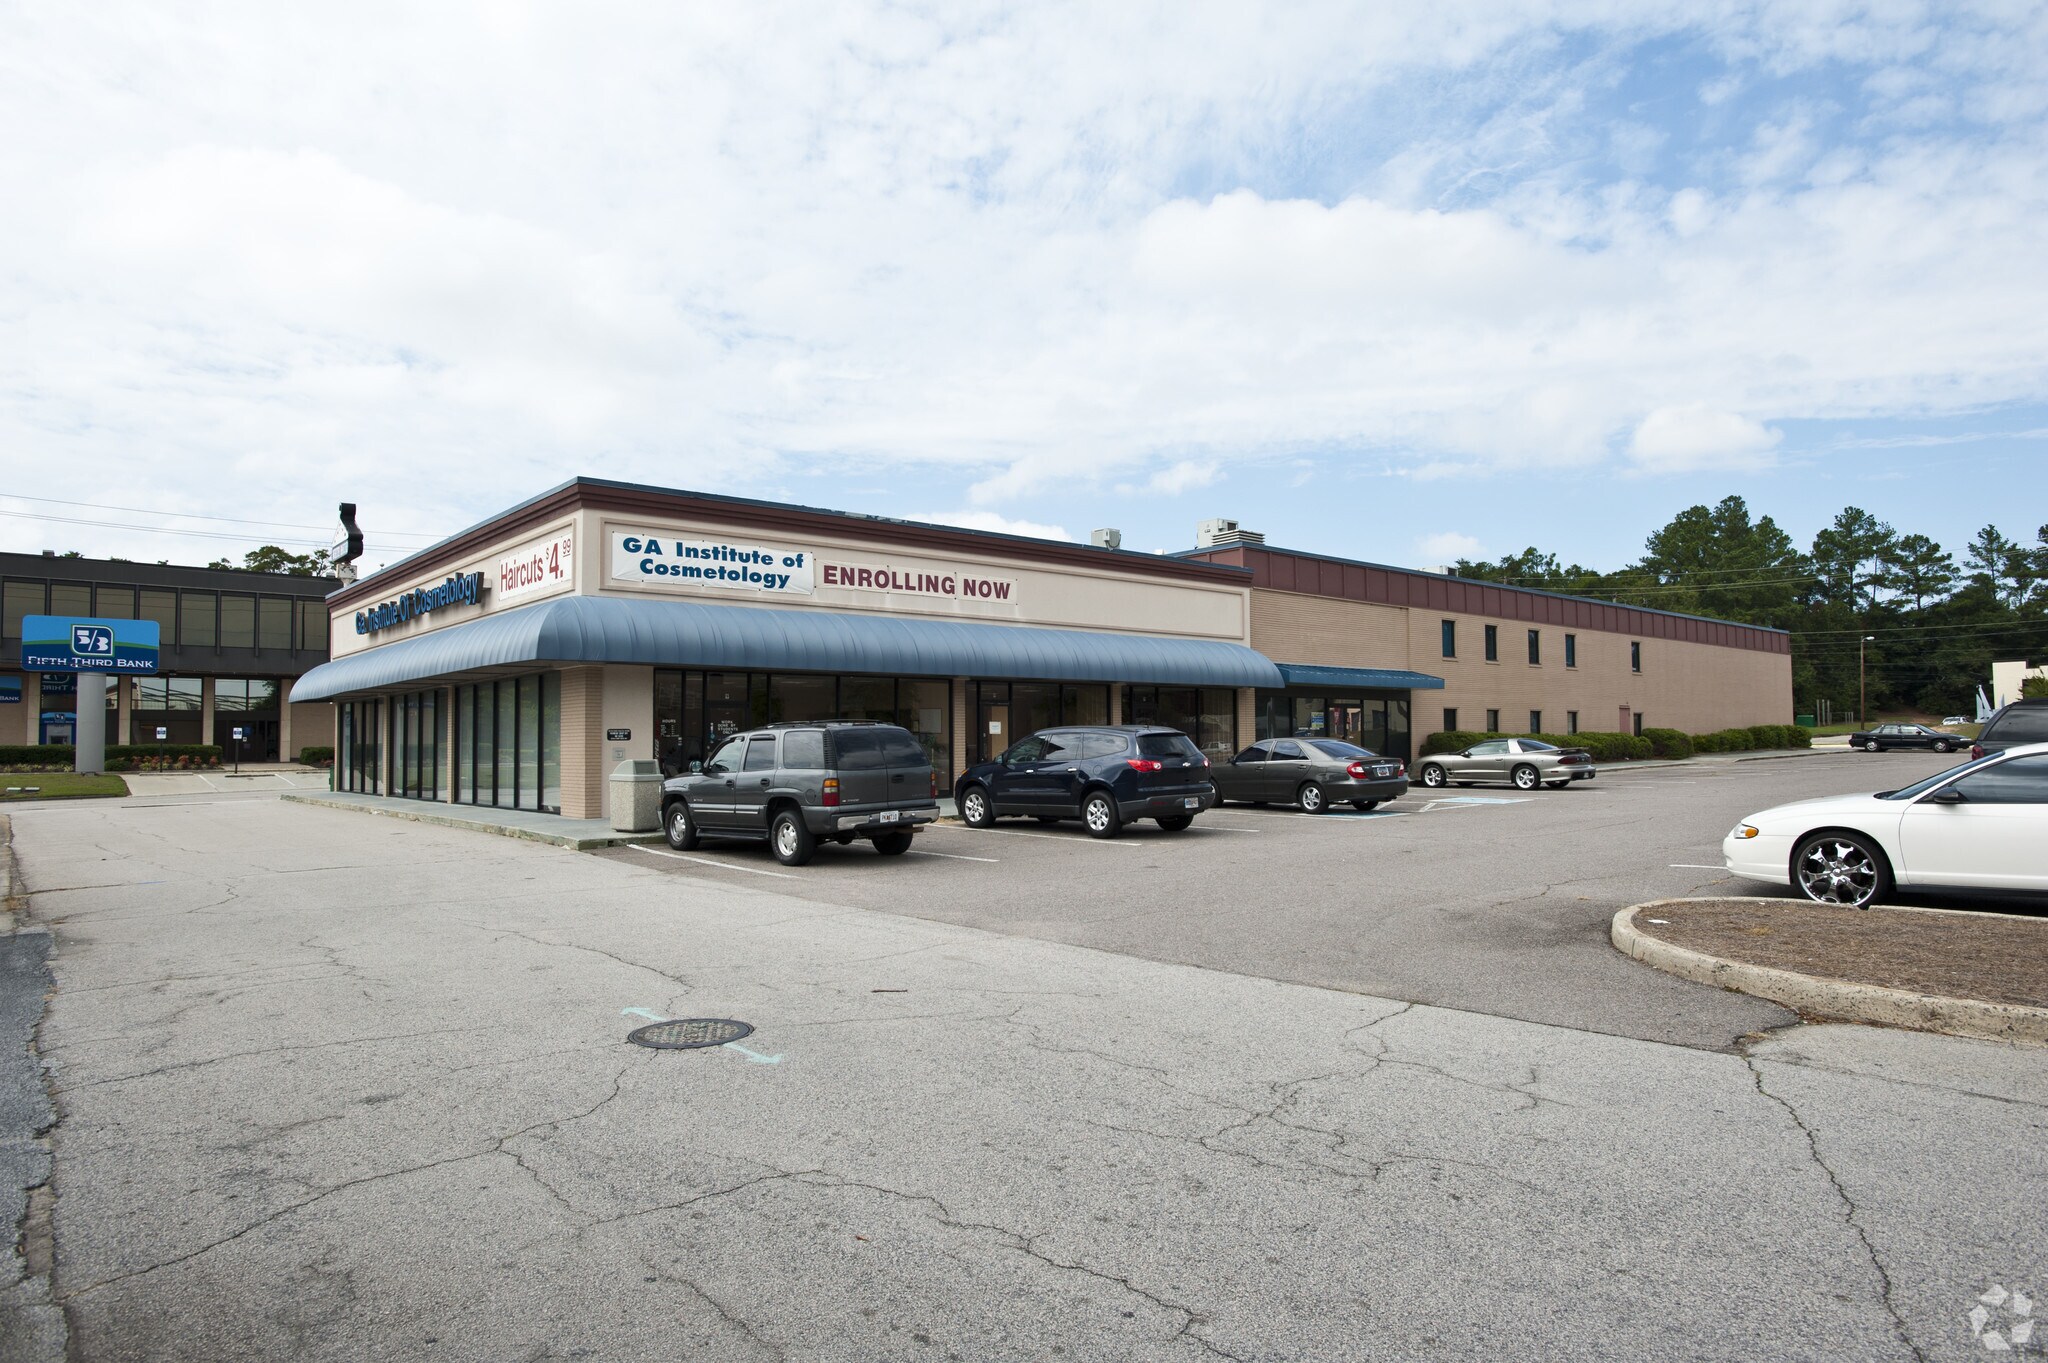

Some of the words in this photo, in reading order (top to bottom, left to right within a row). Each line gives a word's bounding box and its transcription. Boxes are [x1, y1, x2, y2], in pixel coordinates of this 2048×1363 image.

[623, 537, 663, 555] GA
[676, 542, 773, 566] Institute
[782, 553, 804, 568] of
[501, 554, 543, 592] Haircuts
[640, 558, 790, 589] Cosmetology
[823, 565, 955, 594] ENROLLING
[963, 579, 1010, 599] NOW
[368, 602, 398, 632] Institute
[400, 594, 411, 622] Of
[414, 573, 479, 614] Cosmetology
[28, 656, 67, 665] FIFTH
[71, 657, 113, 667] THIRD
[117, 658, 153, 668] BANK
